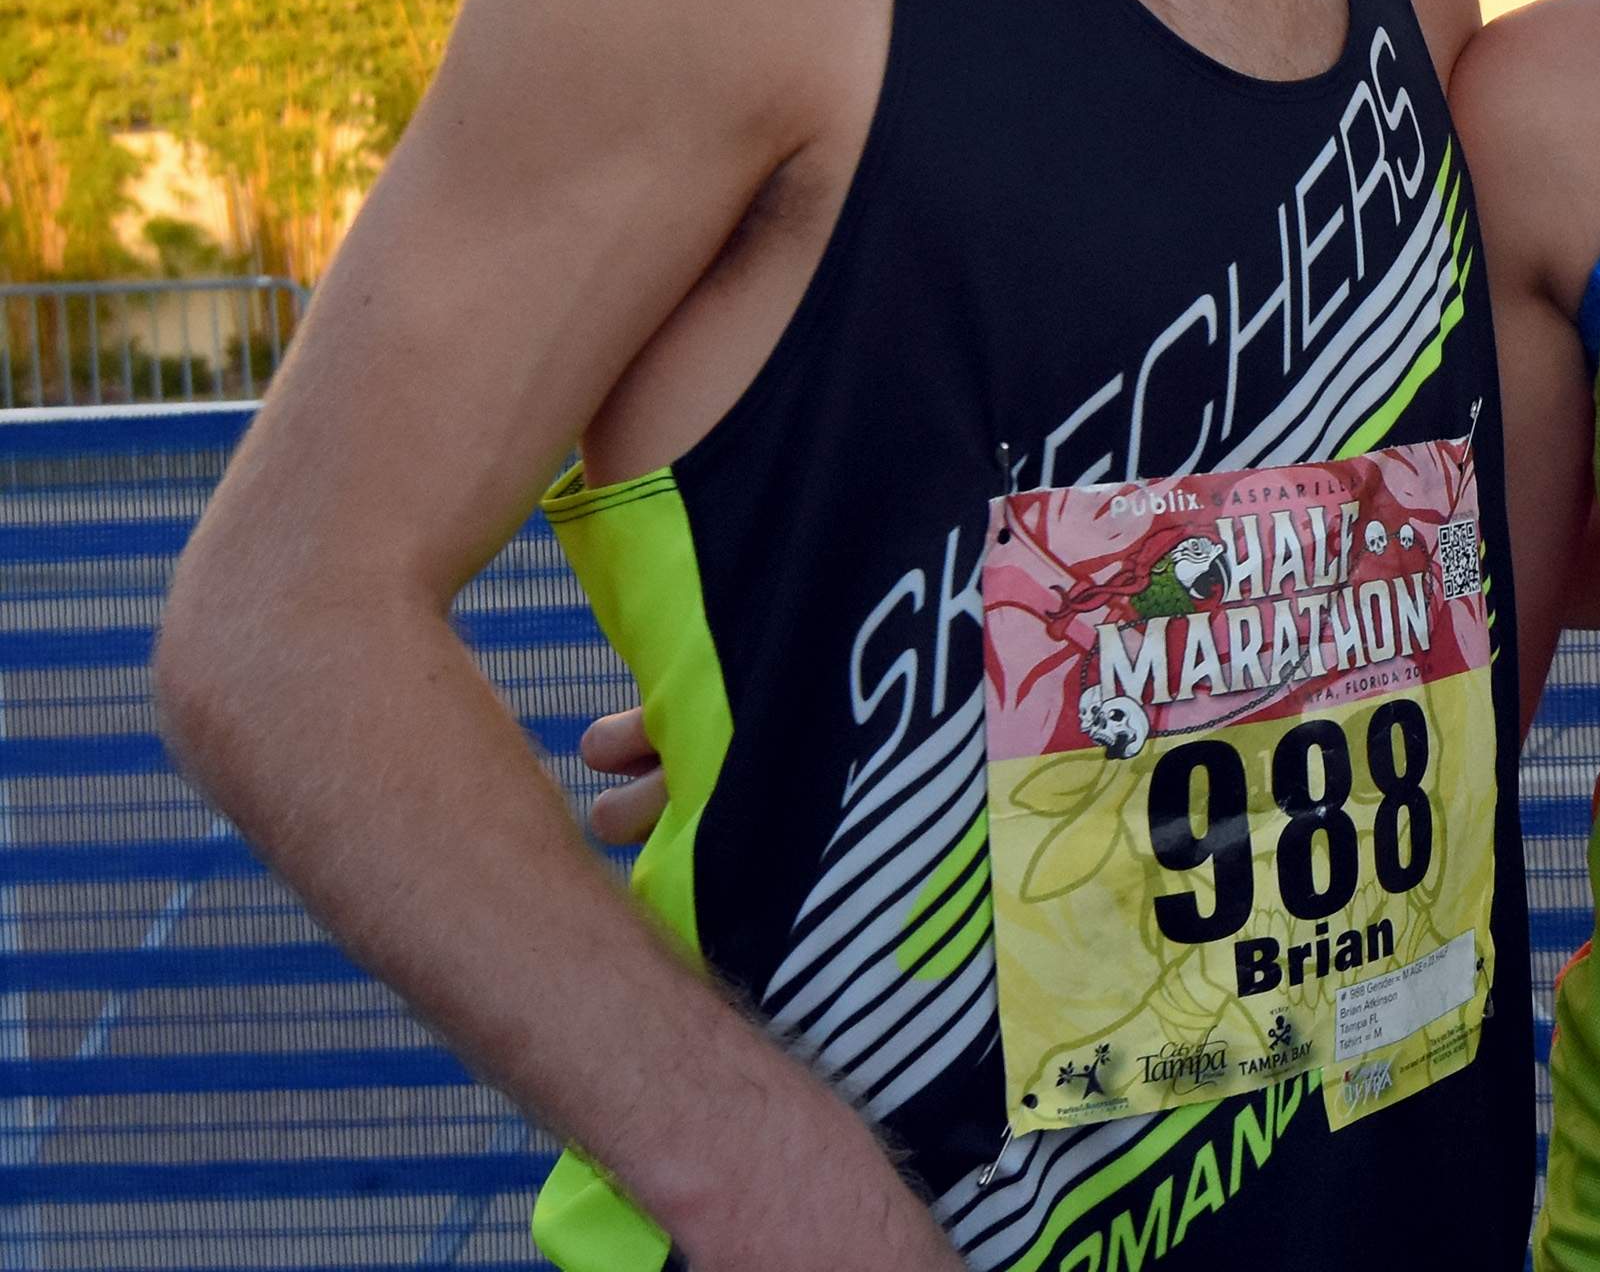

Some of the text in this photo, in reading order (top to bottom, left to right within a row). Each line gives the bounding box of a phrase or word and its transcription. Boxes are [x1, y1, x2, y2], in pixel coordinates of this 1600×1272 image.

[1215, 501, 1360, 603] HALF
[1096, 573, 1432, 705] MARATHON
[1346, 672, 1399, 695] FLORIDA
[1147, 698, 1433, 944] 988
[1234, 918, 1394, 998] Brian
[1340, 991, 1398, 1019] Brian Atkinson
[1137, 1044, 1229, 1095] Tampa
[1238, 1048, 1289, 1076] TAMPA
[1290, 1039, 1314, 1064] BAY
